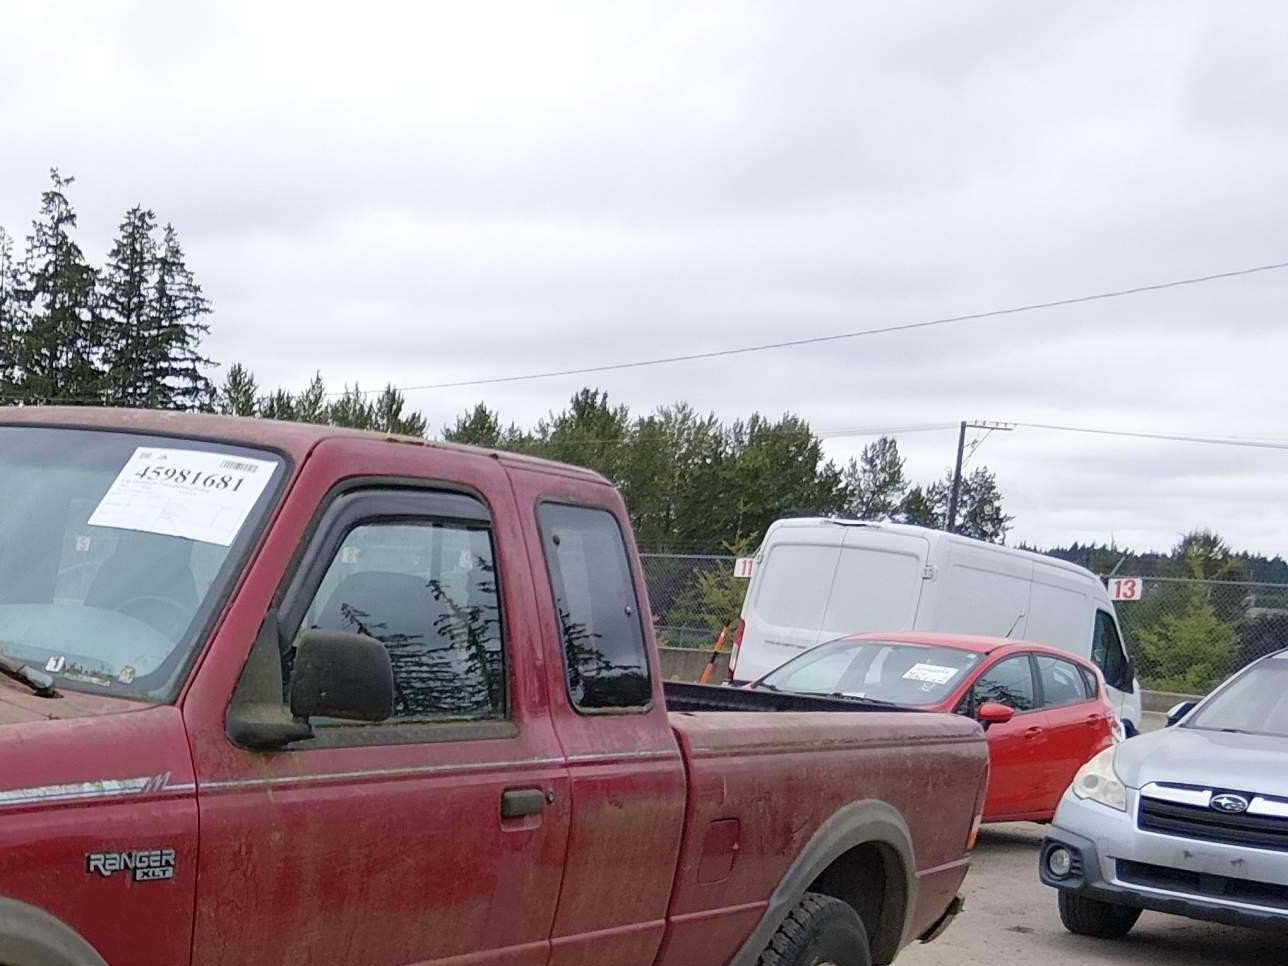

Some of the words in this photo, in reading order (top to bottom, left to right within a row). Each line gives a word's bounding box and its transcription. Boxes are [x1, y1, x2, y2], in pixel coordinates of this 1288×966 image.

[135, 464, 245, 492] 45981681
[741, 559, 753, 576] 11
[1114, 579, 1137, 599] 13
[88, 848, 175, 876] RANGER
[140, 868, 170, 879] XLT
